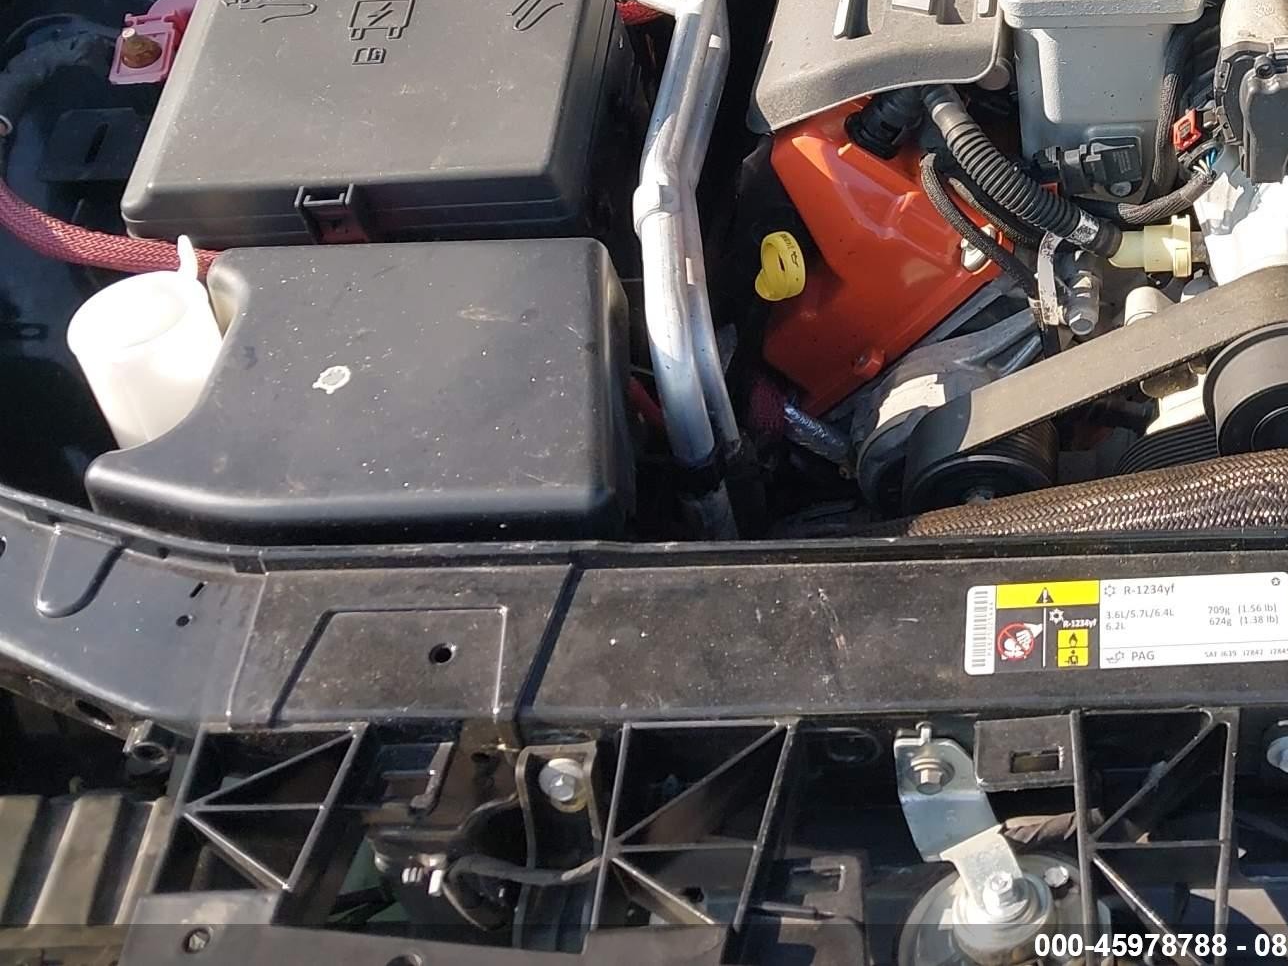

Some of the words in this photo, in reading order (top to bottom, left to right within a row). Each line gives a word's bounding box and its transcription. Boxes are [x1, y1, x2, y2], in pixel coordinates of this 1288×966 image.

[1124, 583, 1175, 596] R-1234yf
[1106, 608, 1174, 620] 3.6L/5.7L/6.4L
[1208, 605, 1230, 616] 709g
[1238, 604, 1262, 614] (1.56
[1264, 603, 1277, 614] lb)
[1105, 622, 1126, 631] 6.2L
[1209, 617, 1232, 627] 624g
[1239, 616, 1264, 626] (1.38
[1266, 615, 1279, 625] lb)
[1131, 650, 1155, 661] PAG
